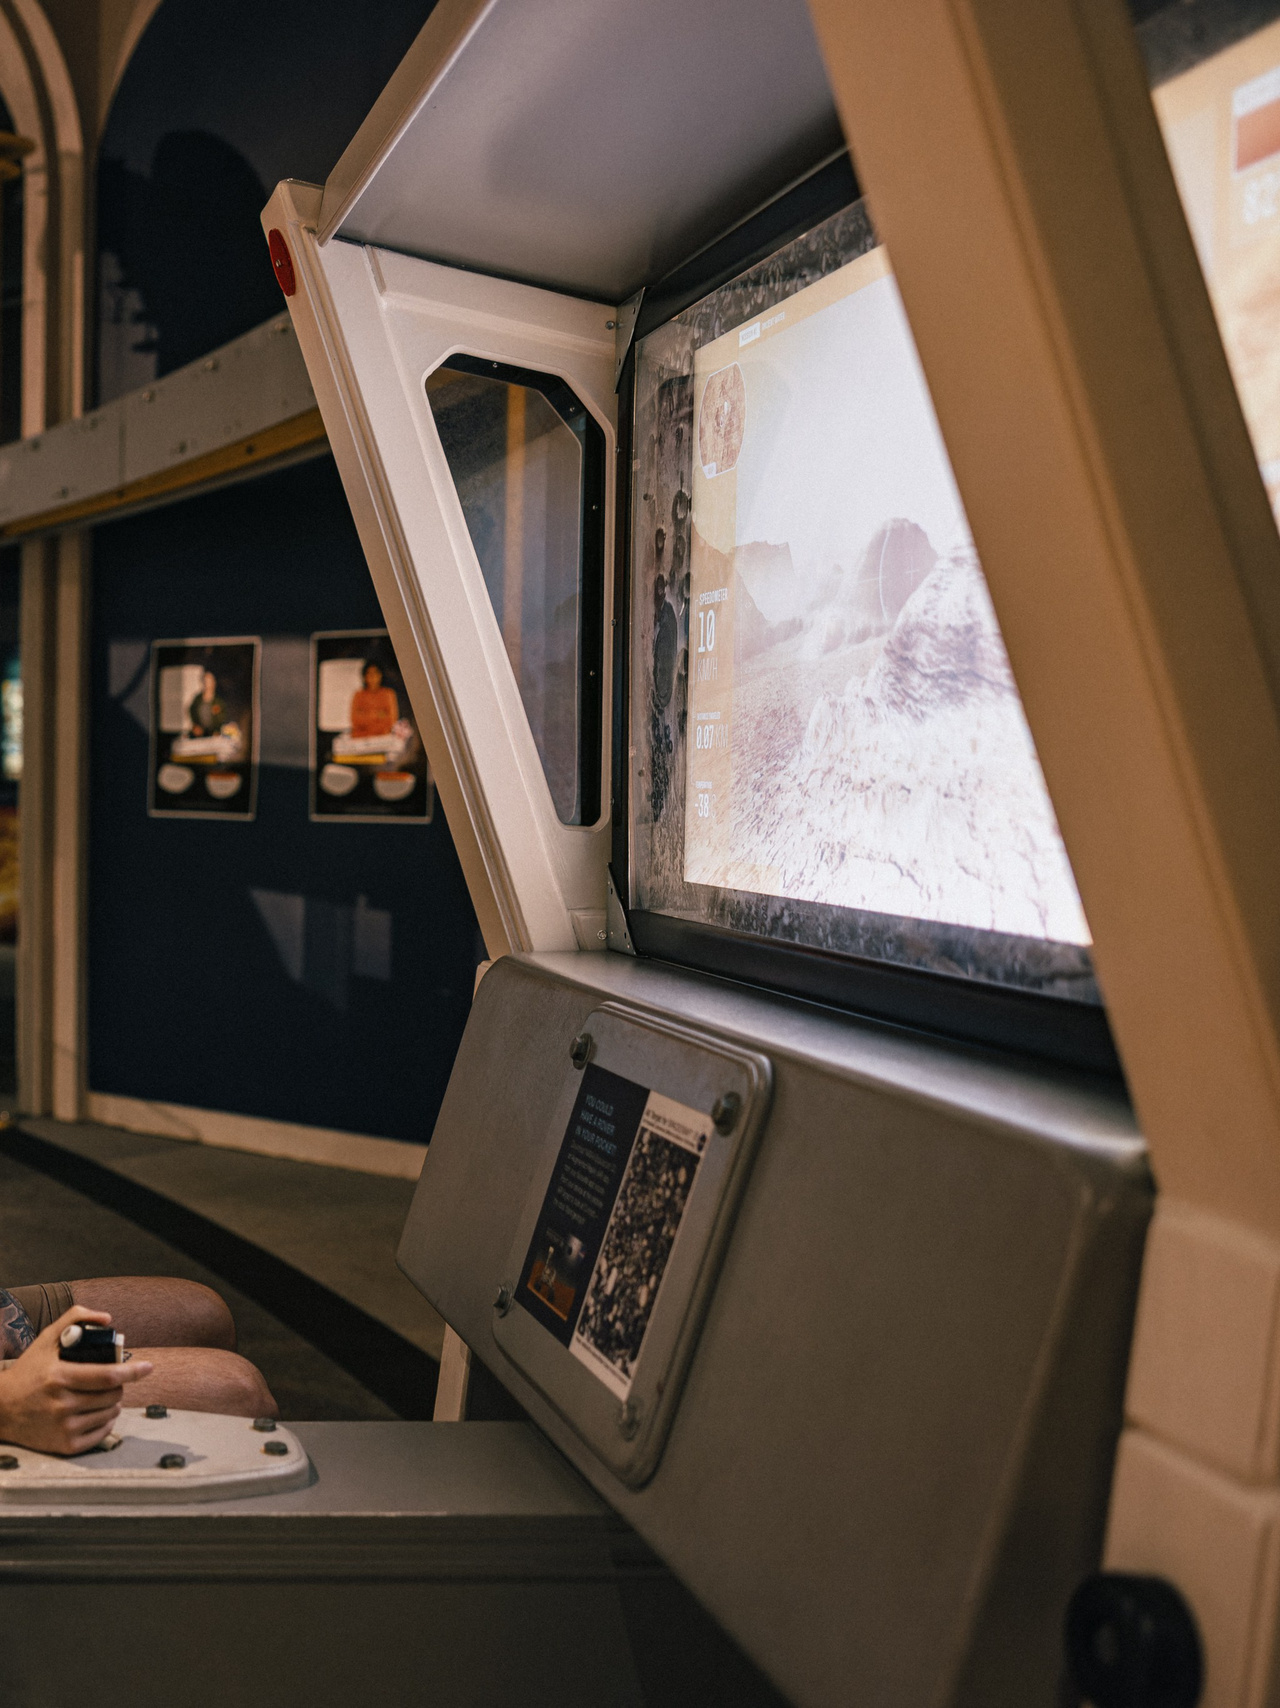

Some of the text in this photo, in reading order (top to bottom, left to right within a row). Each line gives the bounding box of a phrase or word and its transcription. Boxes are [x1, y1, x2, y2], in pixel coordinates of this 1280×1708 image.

[699, 588, 728, 606] SPEEDOMETER
[698, 609, 715, 653] 10
[697, 657, 718, 682] KM/H
[696, 724, 714, 749] 0.07
[694, 794, 709, 818] -38
